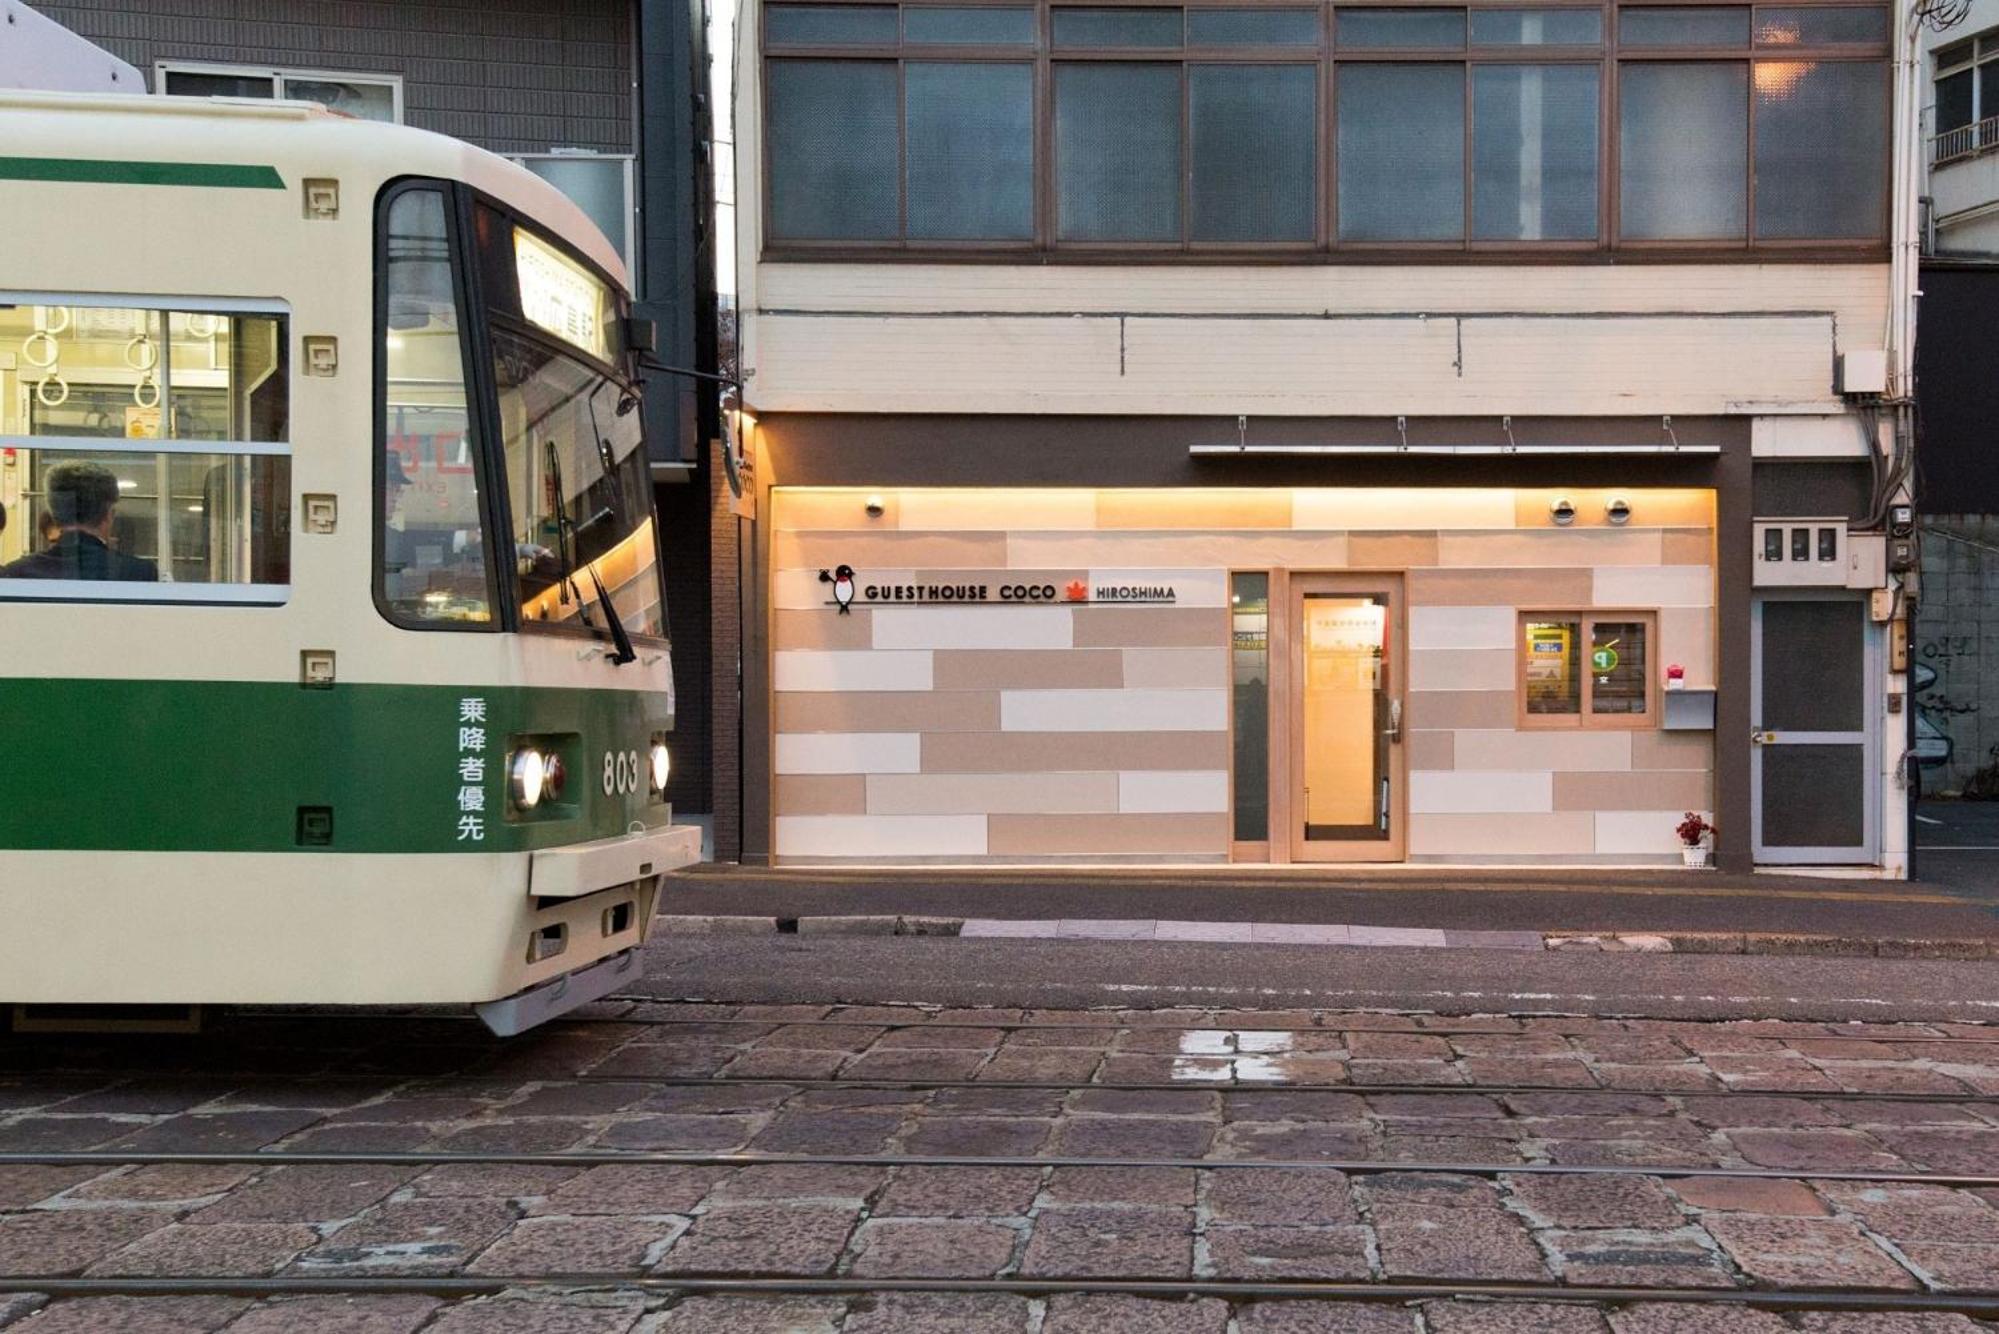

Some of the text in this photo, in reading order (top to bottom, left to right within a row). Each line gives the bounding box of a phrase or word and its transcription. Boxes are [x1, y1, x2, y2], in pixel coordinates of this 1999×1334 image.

[864, 585, 1176, 600] GUESTHOUSE COCO HIROSHIMA
[457, 697, 487, 842] 乗降者優先
[603, 750, 639, 796] 803
